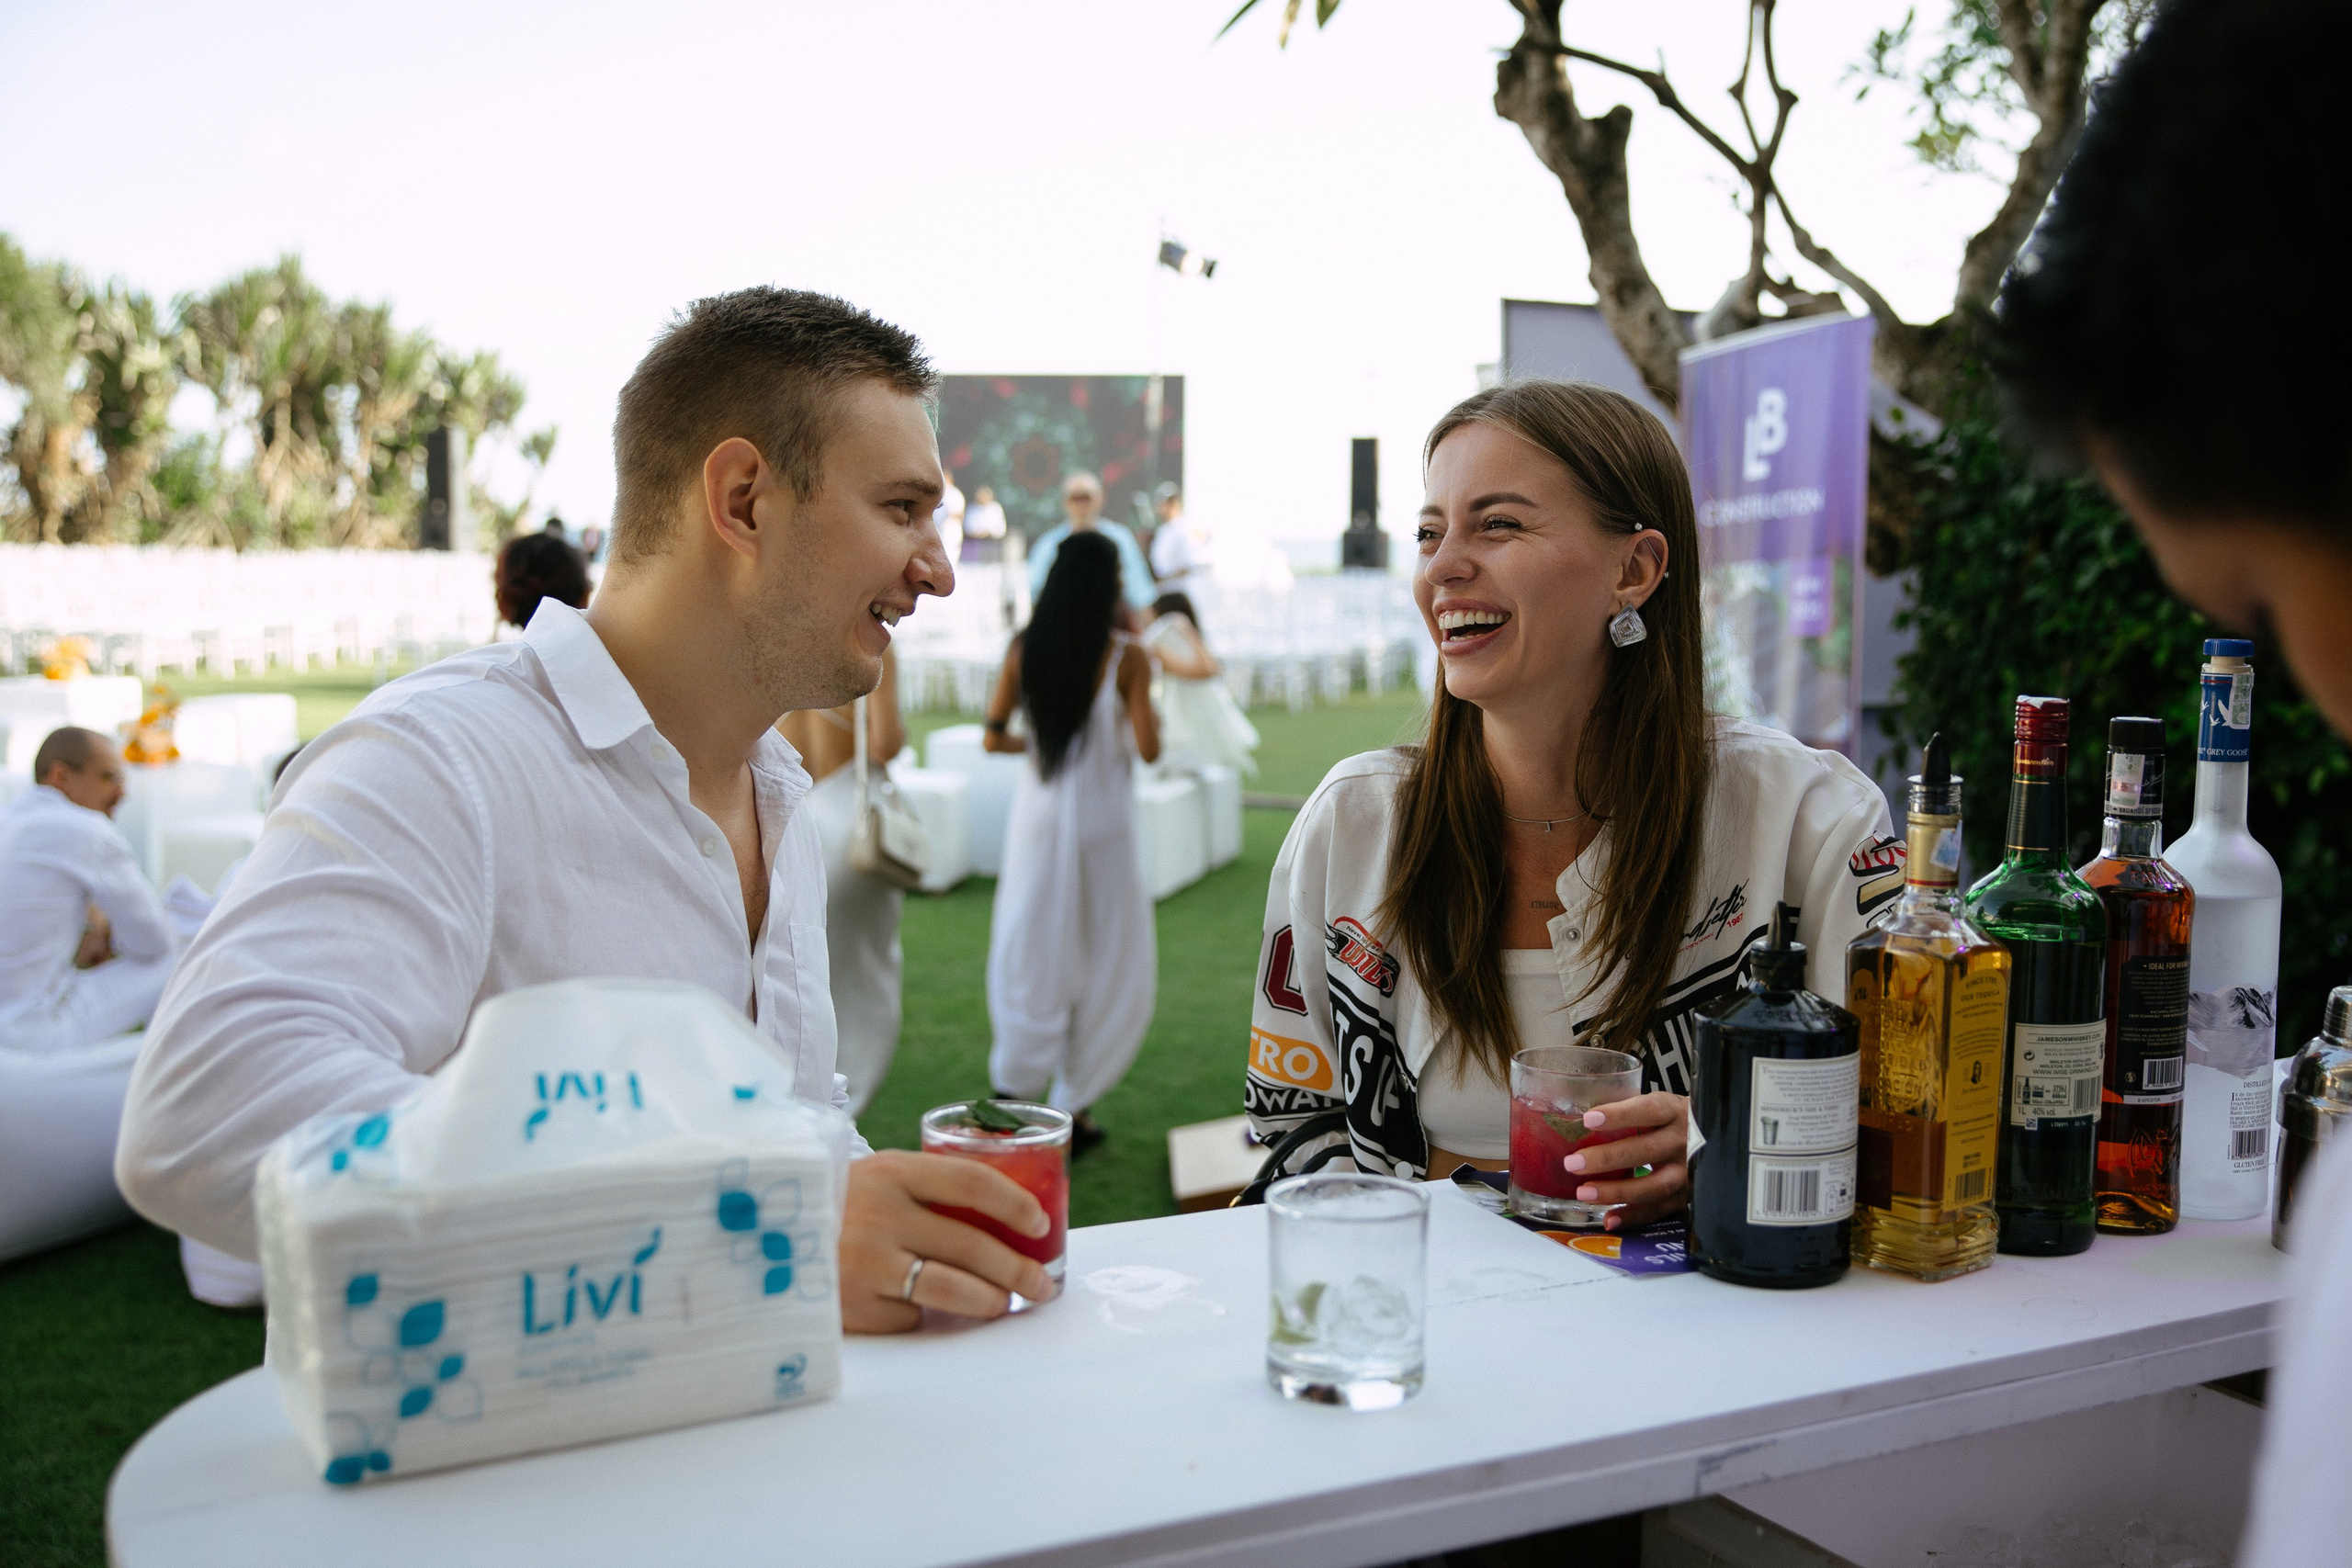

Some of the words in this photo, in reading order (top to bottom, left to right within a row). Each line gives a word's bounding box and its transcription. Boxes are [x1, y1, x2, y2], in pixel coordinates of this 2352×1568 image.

[2206, 748, 2225, 756] GREY
[1727, 912, 1744, 928] 1987
[2032, 1107, 2045, 1115] 40%
[523, 1227, 661, 1336] Livi
